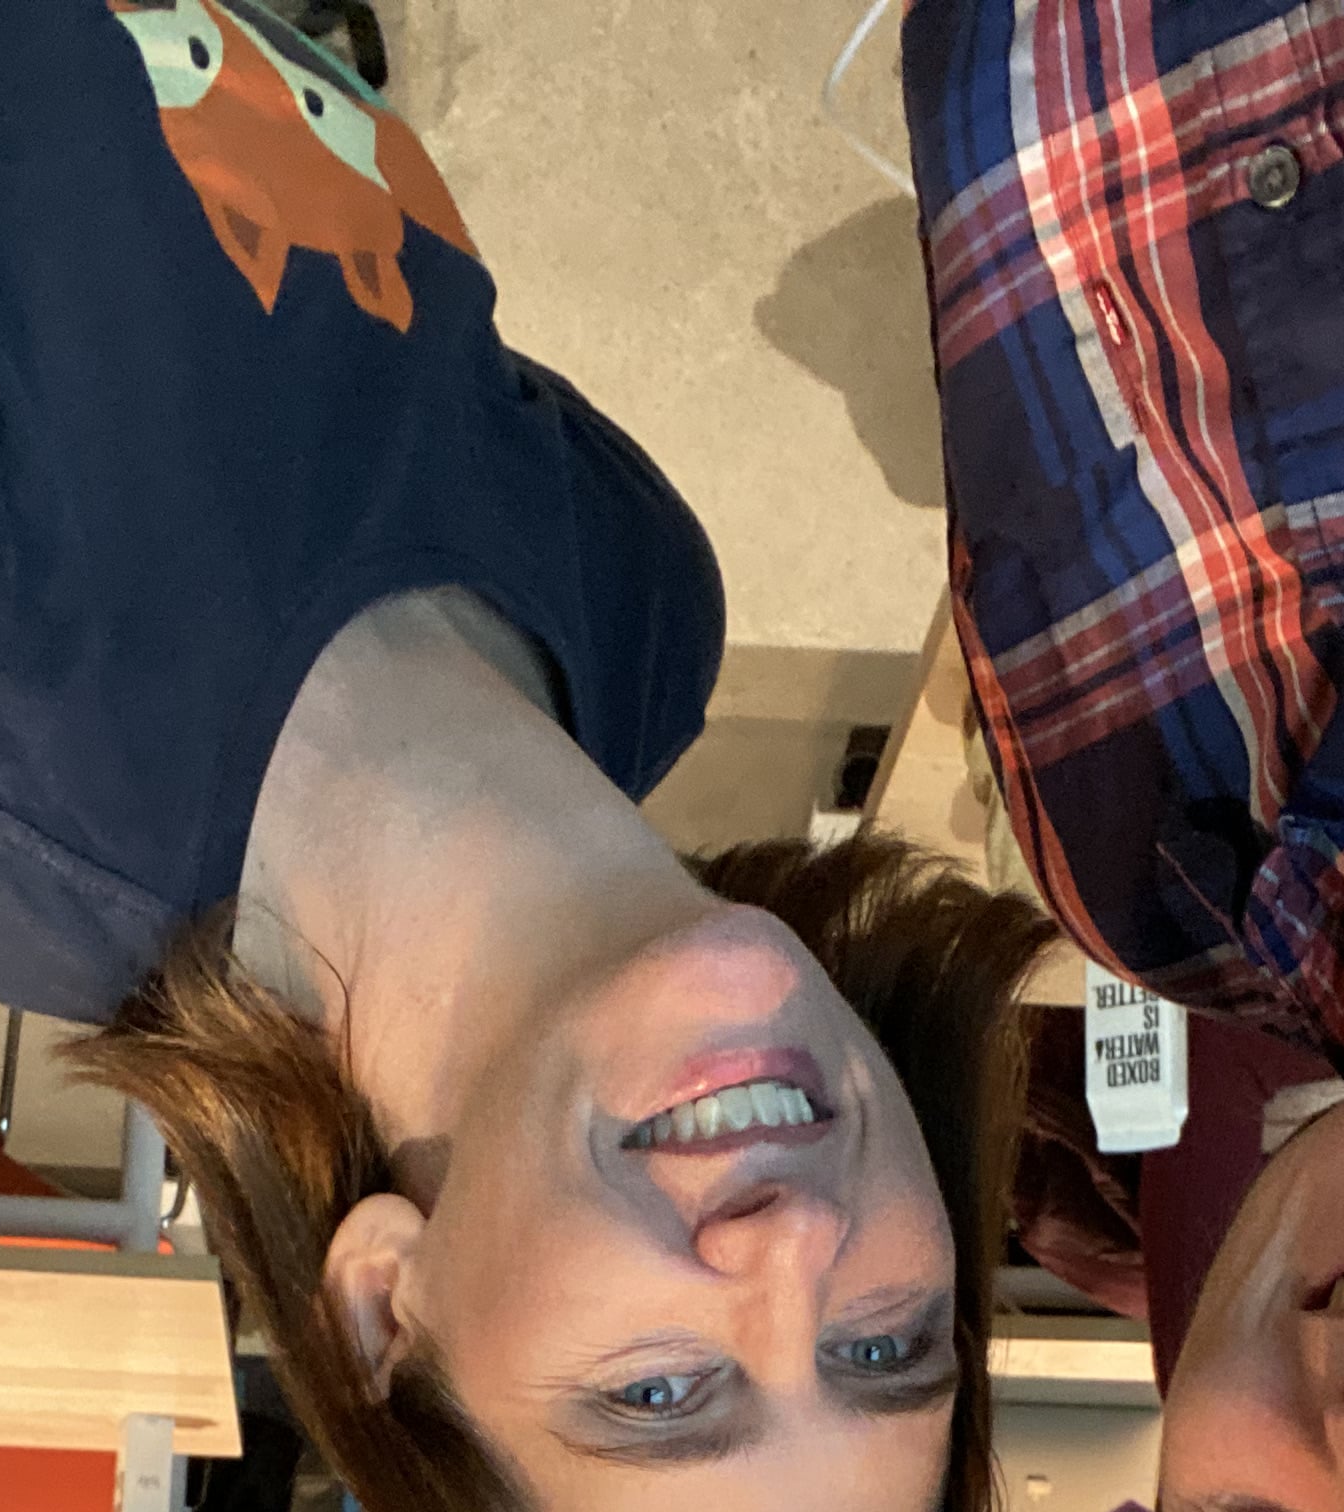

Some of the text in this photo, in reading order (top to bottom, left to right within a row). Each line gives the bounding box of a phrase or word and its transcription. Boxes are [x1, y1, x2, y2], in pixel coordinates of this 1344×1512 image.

[1143, 1005, 1159, 1029] IS
[1105, 1032, 1160, 1060] WATER
[1106, 1059, 1160, 1088] BOXED
